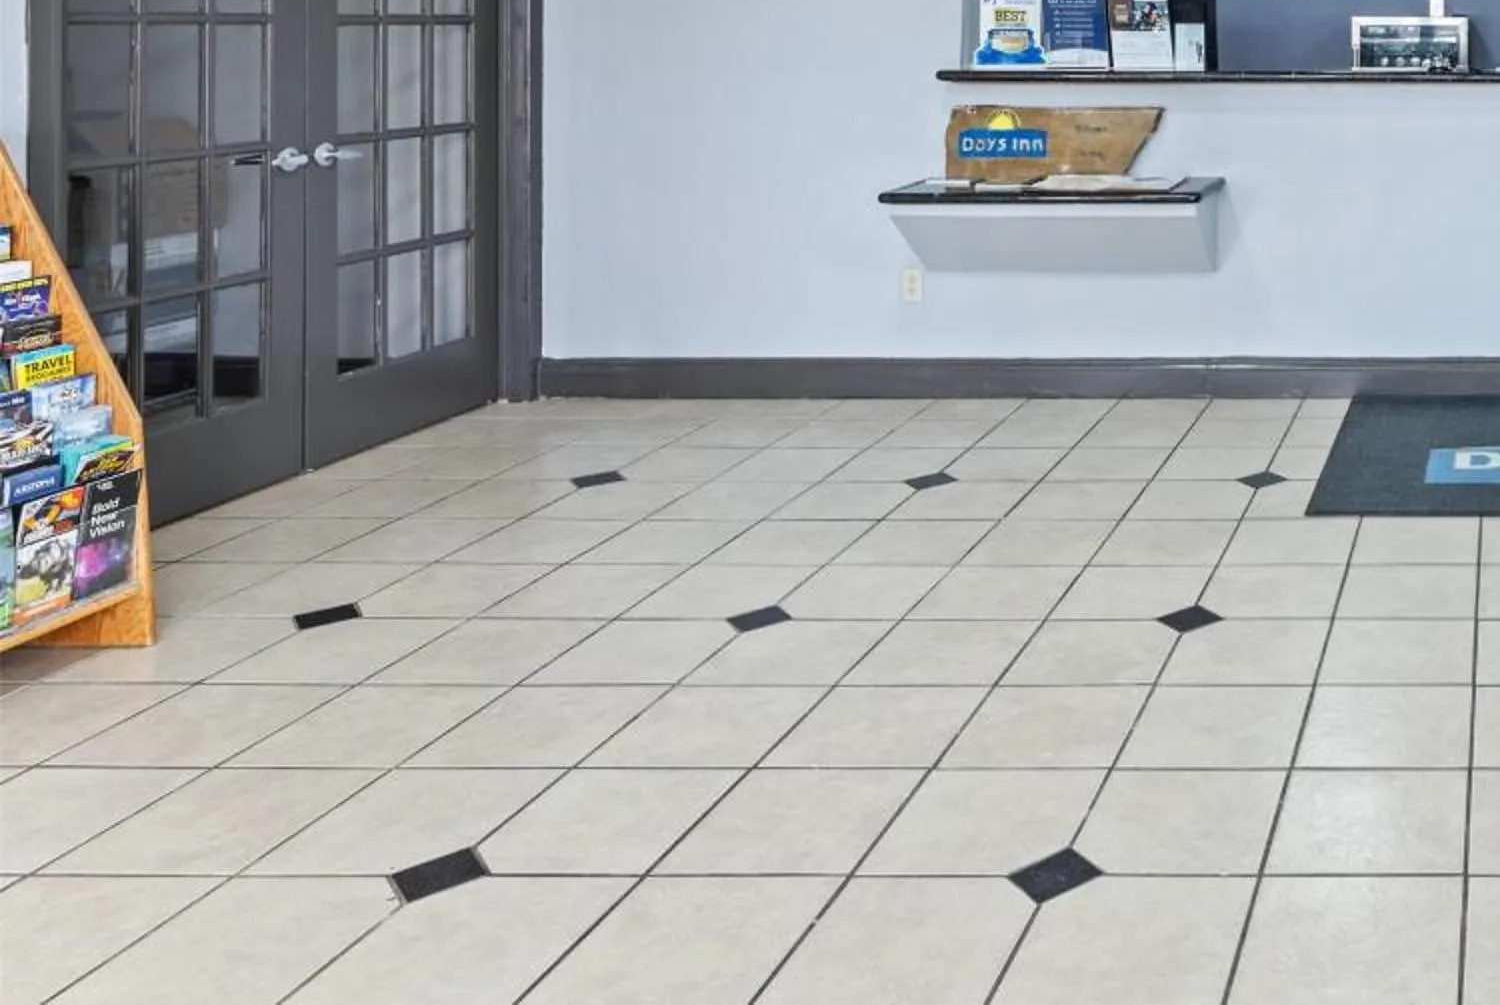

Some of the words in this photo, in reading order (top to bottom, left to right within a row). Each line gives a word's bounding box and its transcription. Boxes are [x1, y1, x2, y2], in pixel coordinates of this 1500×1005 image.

[995, 10, 1026, 22] BEST
[24, 355, 72, 373] TRAVEL
[91, 497, 120, 515] Bold
[90, 510, 117, 527] New
[89, 520, 125, 539] Vision
